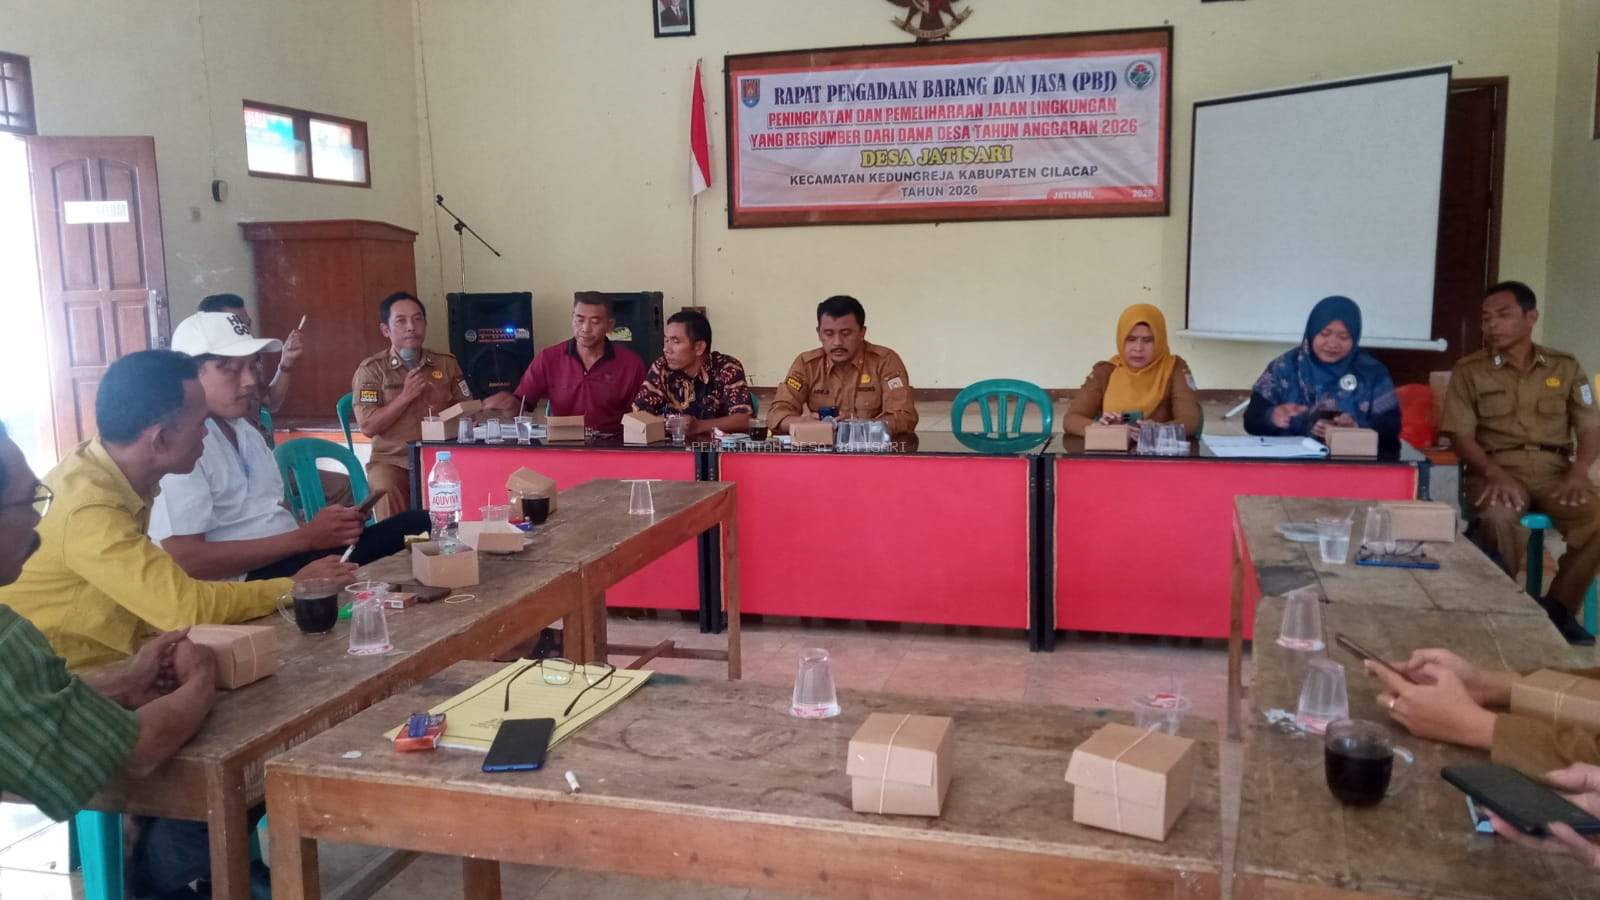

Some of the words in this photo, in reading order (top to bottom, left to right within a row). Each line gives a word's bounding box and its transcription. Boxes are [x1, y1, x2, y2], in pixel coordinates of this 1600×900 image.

[774, 85, 822, 105] RAPAT
[827, 80, 917, 103] PENGADAAN
[923, 76, 987, 98] BARANG
[993, 74, 1025, 95] DAN
[1030, 72, 1066, 95] JASA
[1072, 70, 1118, 93] (PBJ)
[768, 108, 853, 127] PENINGKATAN
[856, 107, 883, 123] DAN
[885, 102, 984, 121] PEMELIHARAAN
[986, 100, 1027, 117] JALAN
[1030, 97, 1117, 115] LINGKUNGAN
[750, 132, 783, 148] YANG
[786, 130, 861, 146] BERSUMBER
[864, 128, 894, 143] DARI
[899, 127, 933, 142] DANA
[938, 124, 970, 140] DESA
[974, 122, 1019, 138] TAHUN
[1022, 120, 1098, 137] ANGGARAN
[1102, 118, 1137, 135] 2026
[860, 148, 914, 168] DESA
[917, 144, 1013, 166] JATISARI
[790, 173, 865, 186] KECAMATAN
[869, 170, 955, 183] KEDUNGREJA
[959, 167, 1036, 180] KABUPATEN
[1041, 165, 1098, 178] CILACAP
[901, 186, 944, 198] TAHUN
[949, 185, 978, 196] 2026
